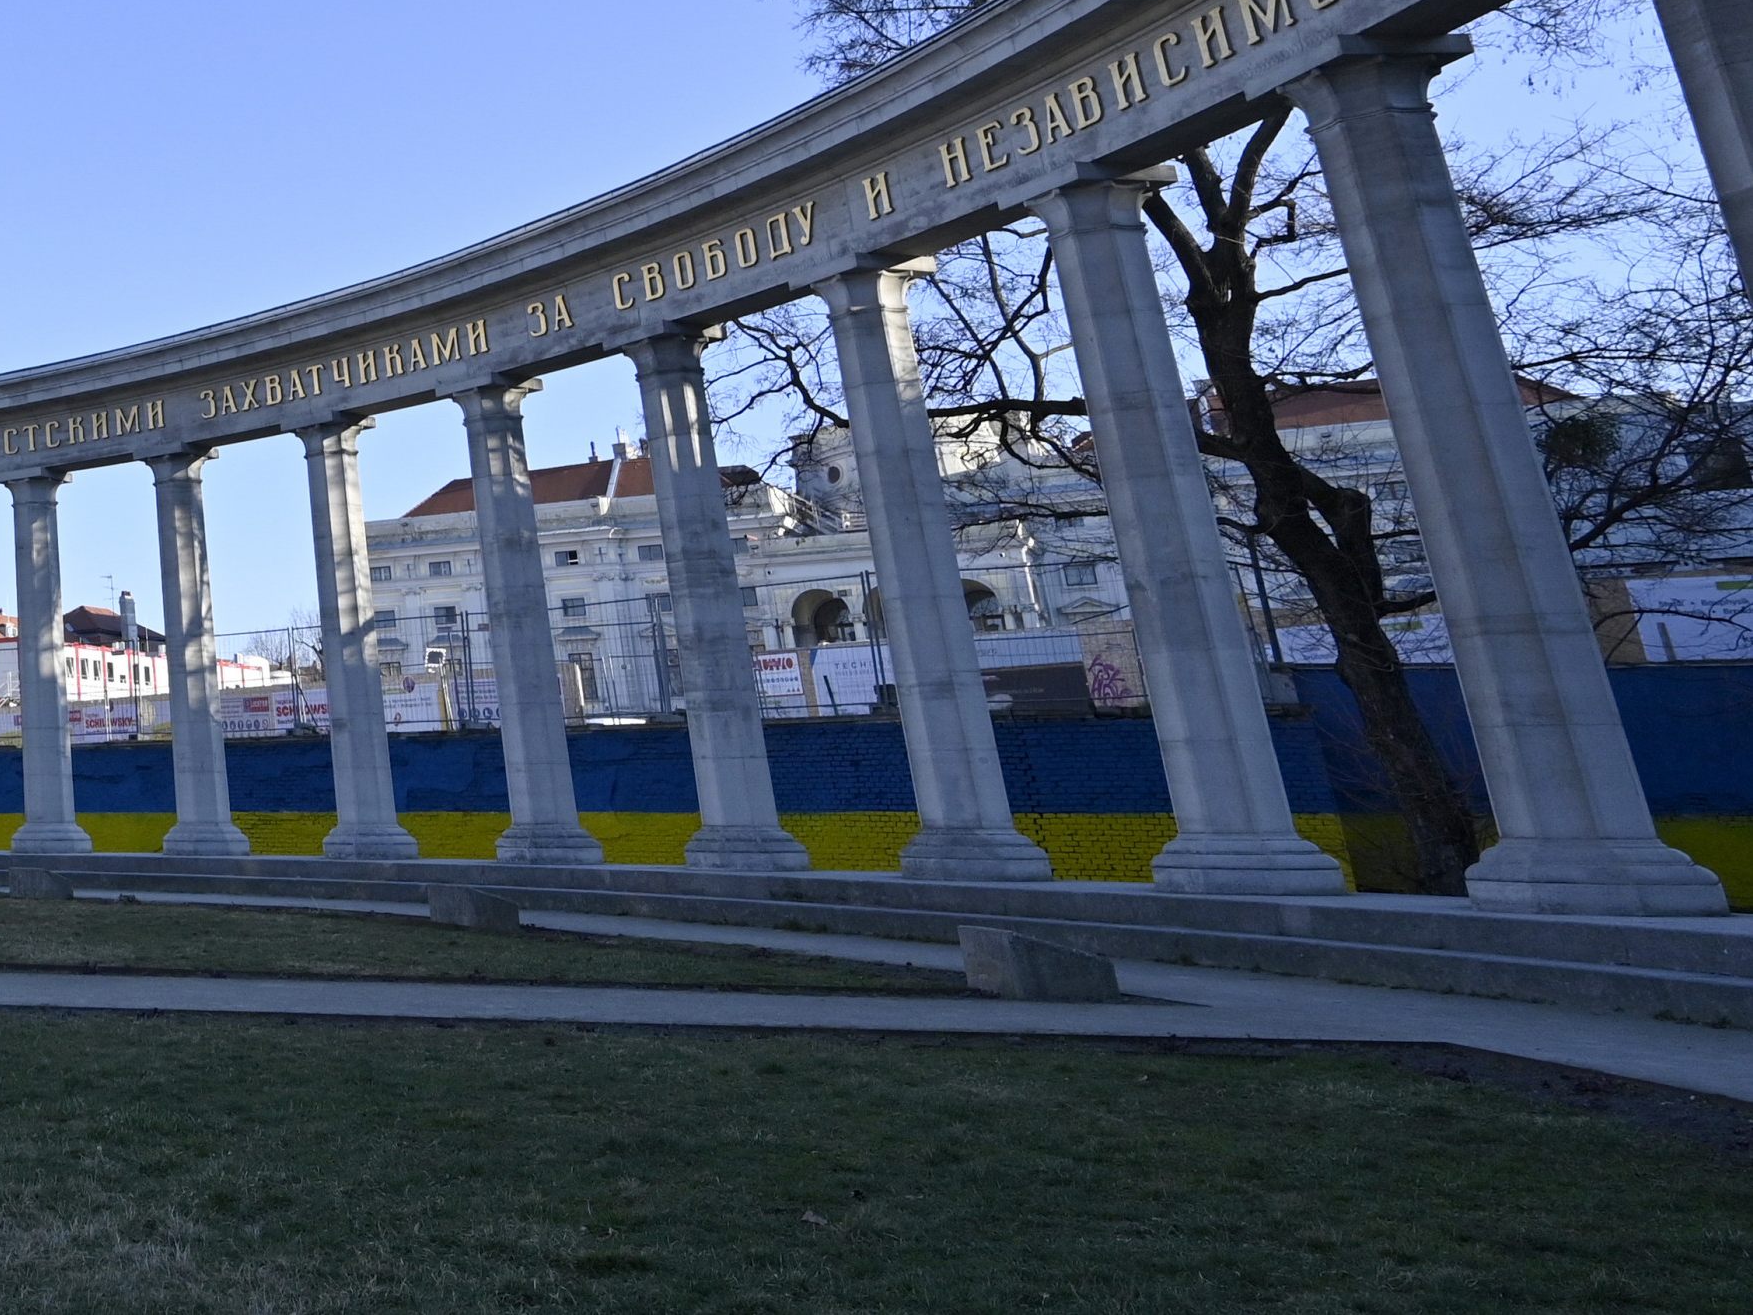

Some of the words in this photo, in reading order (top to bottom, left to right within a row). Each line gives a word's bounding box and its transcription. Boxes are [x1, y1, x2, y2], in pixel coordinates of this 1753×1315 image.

[199, 318, 491, 420] ЗАХВАТЧИКАМИ
[526, 294, 574, 338] ЗА
[612, 200, 815, 311] СВОБОДУ
[862, 171, 895, 221] И
